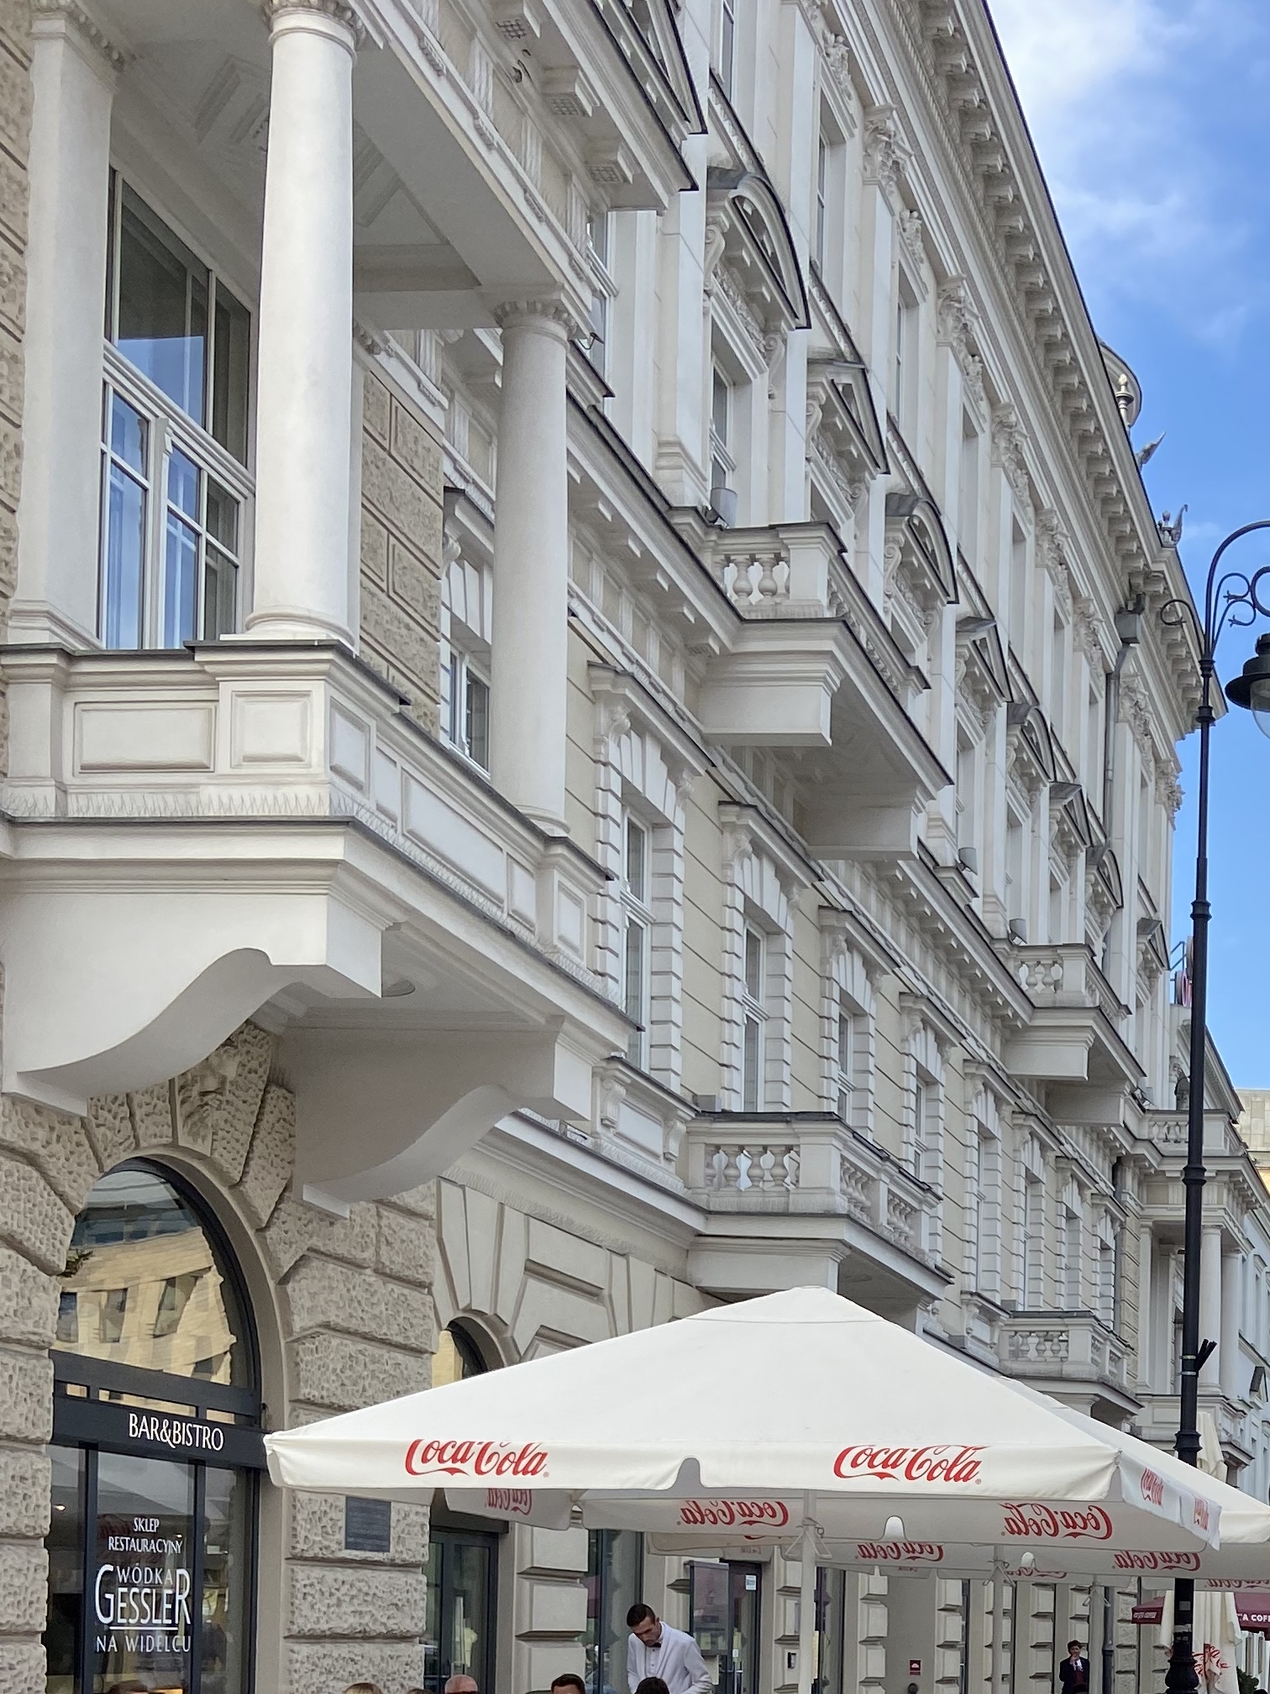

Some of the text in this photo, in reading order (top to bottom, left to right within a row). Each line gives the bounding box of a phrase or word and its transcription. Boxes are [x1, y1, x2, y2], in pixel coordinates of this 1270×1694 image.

[128, 1412, 224, 1451] BAR&BISTRO
[405, 1438, 549, 1477] Coca-Cola
[833, 1443, 992, 1484] Coca-Cola
[133, 1517, 160, 1533] SKLEP
[108, 1536, 183, 1555] RESTAURACYJNY
[116, 1562, 173, 1585] WÓDKA
[94, 1563, 191, 1625] GESSLER
[96, 1635, 191, 1652] NA WIDELCU
